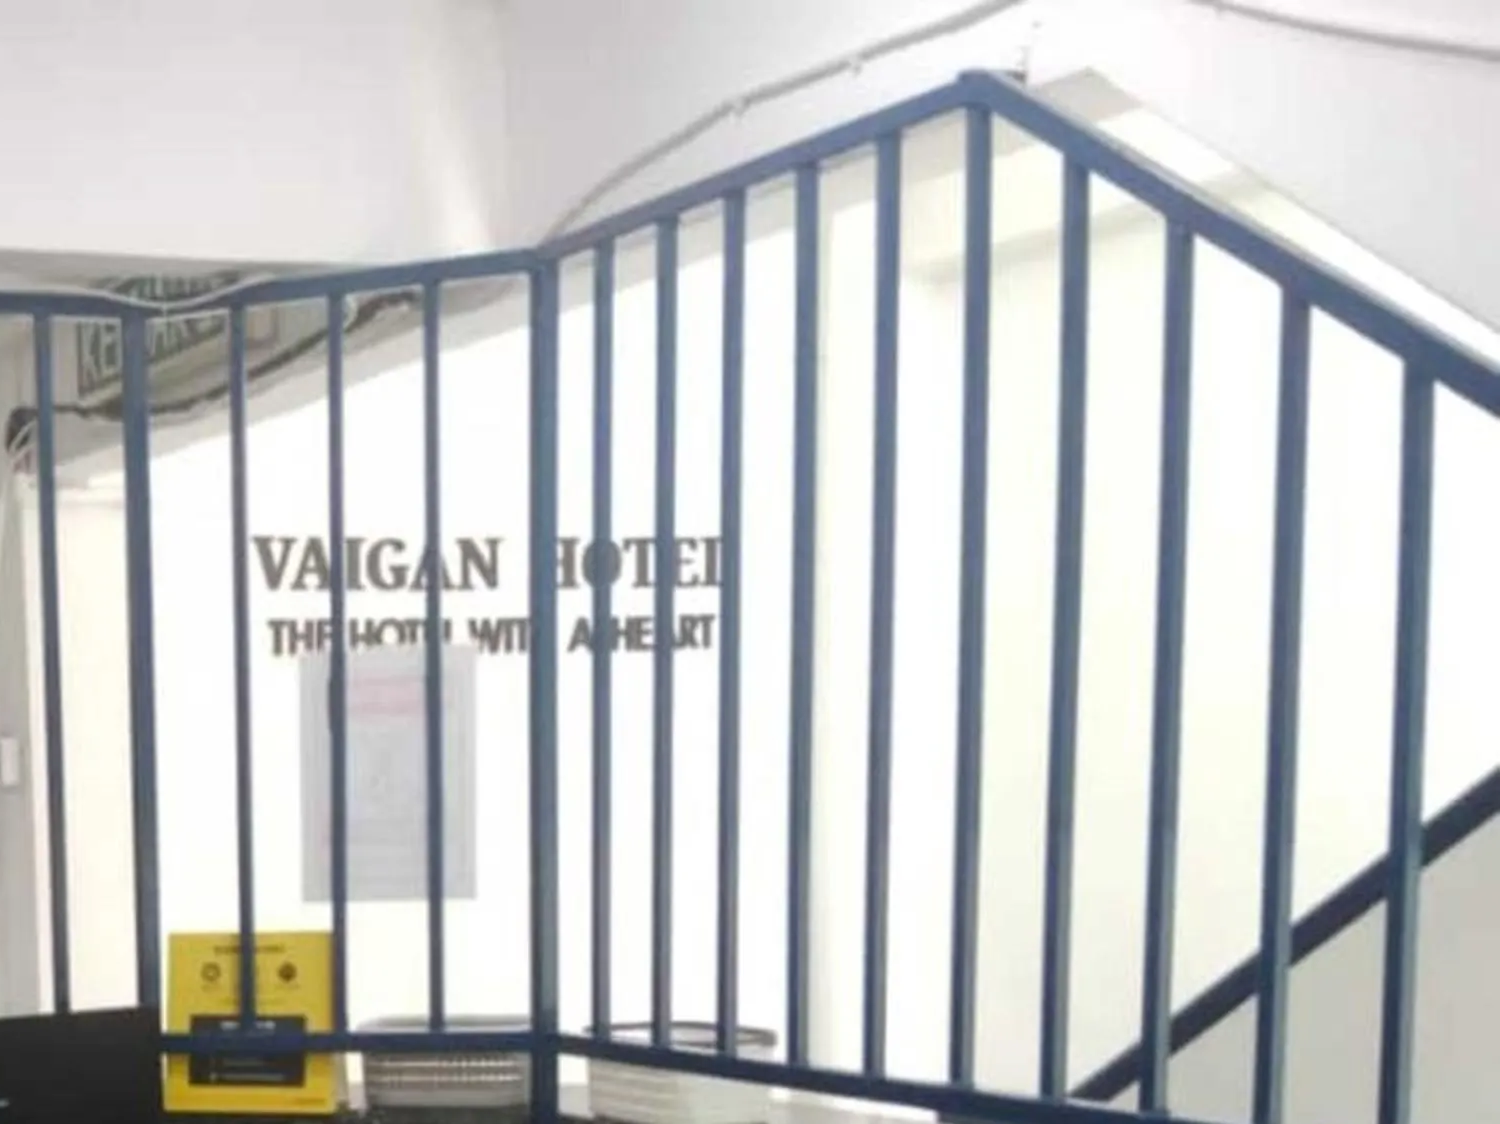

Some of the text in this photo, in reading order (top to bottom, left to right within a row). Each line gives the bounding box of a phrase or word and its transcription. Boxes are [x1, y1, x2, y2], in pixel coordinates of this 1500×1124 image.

[250, 535, 503, 592] VAIGAN
[467, 616, 536, 655] WIT
[608, 613, 716, 653] HERT
